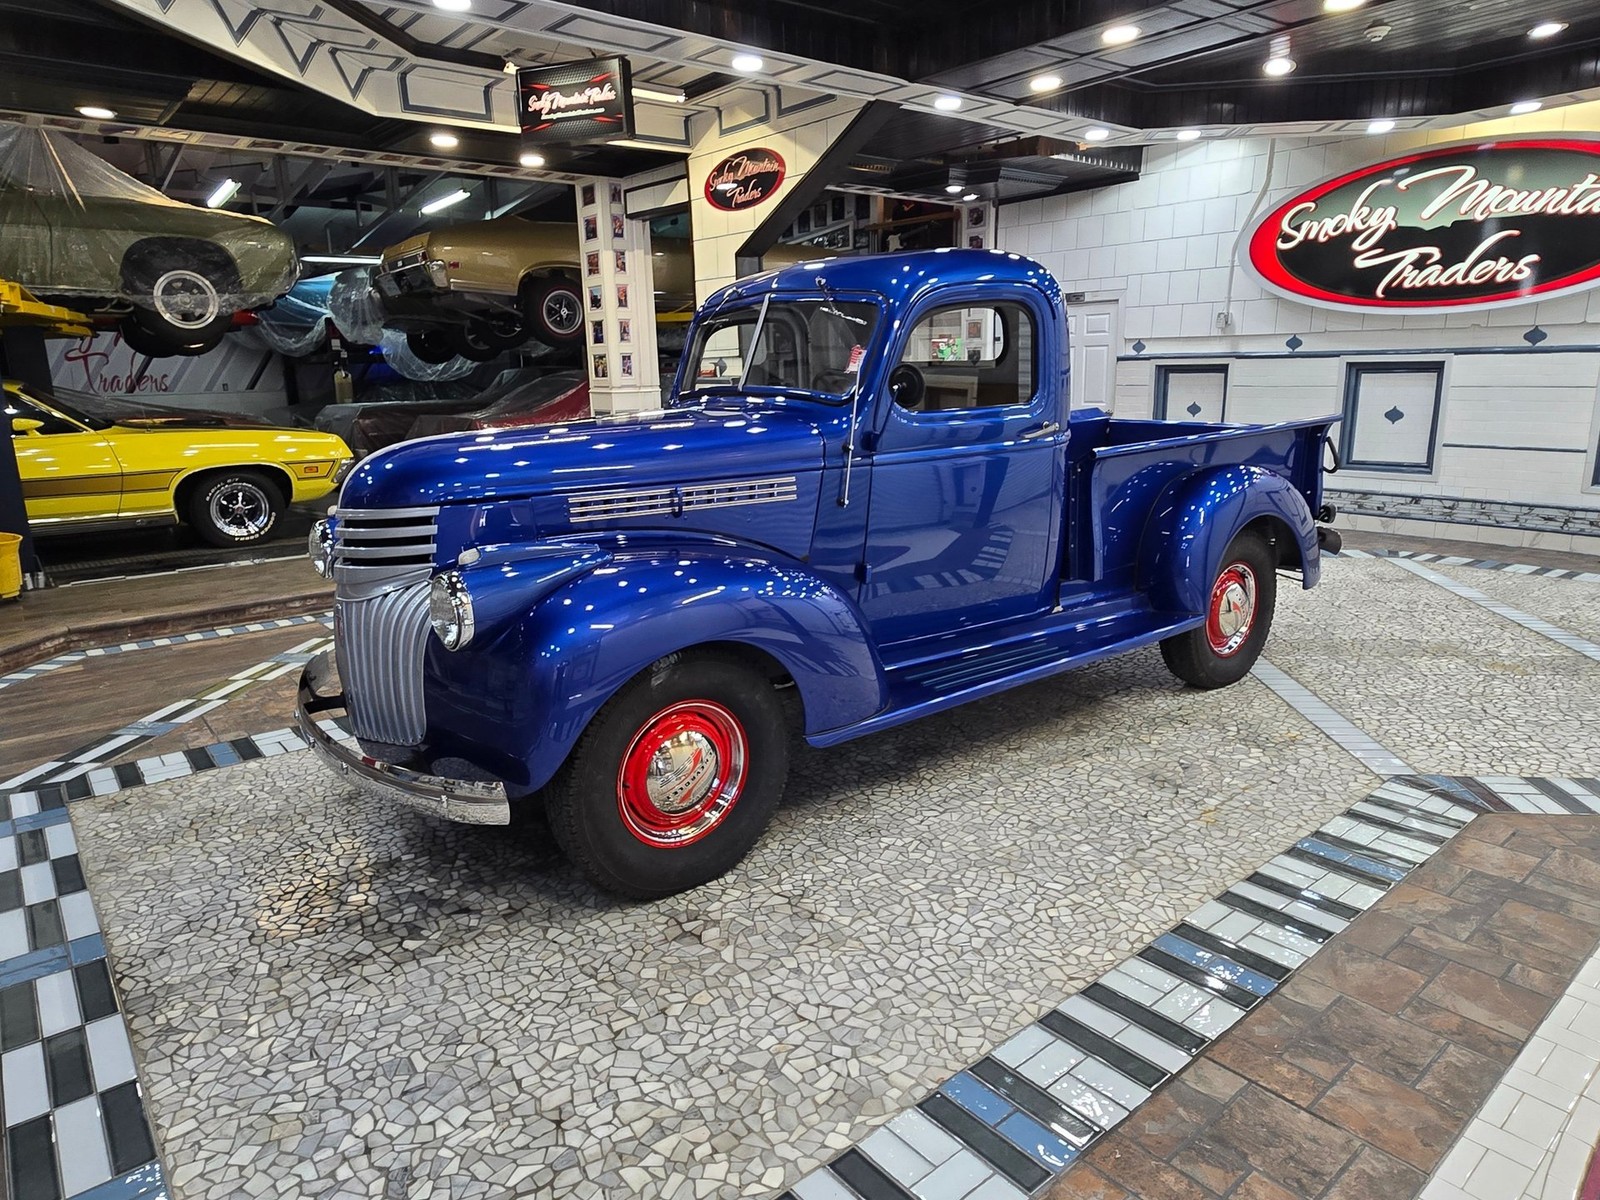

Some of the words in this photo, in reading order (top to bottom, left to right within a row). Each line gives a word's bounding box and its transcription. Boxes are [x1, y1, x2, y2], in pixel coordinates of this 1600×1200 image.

[732, 155, 779, 178] Mountain
[726, 179, 762, 208] Traders
[1276, 178, 1398, 251] Smoky
[1353, 229, 1541, 298] Traders
[64, 348, 170, 394] Traders
[666, 751, 713, 800] CHEVROLET
